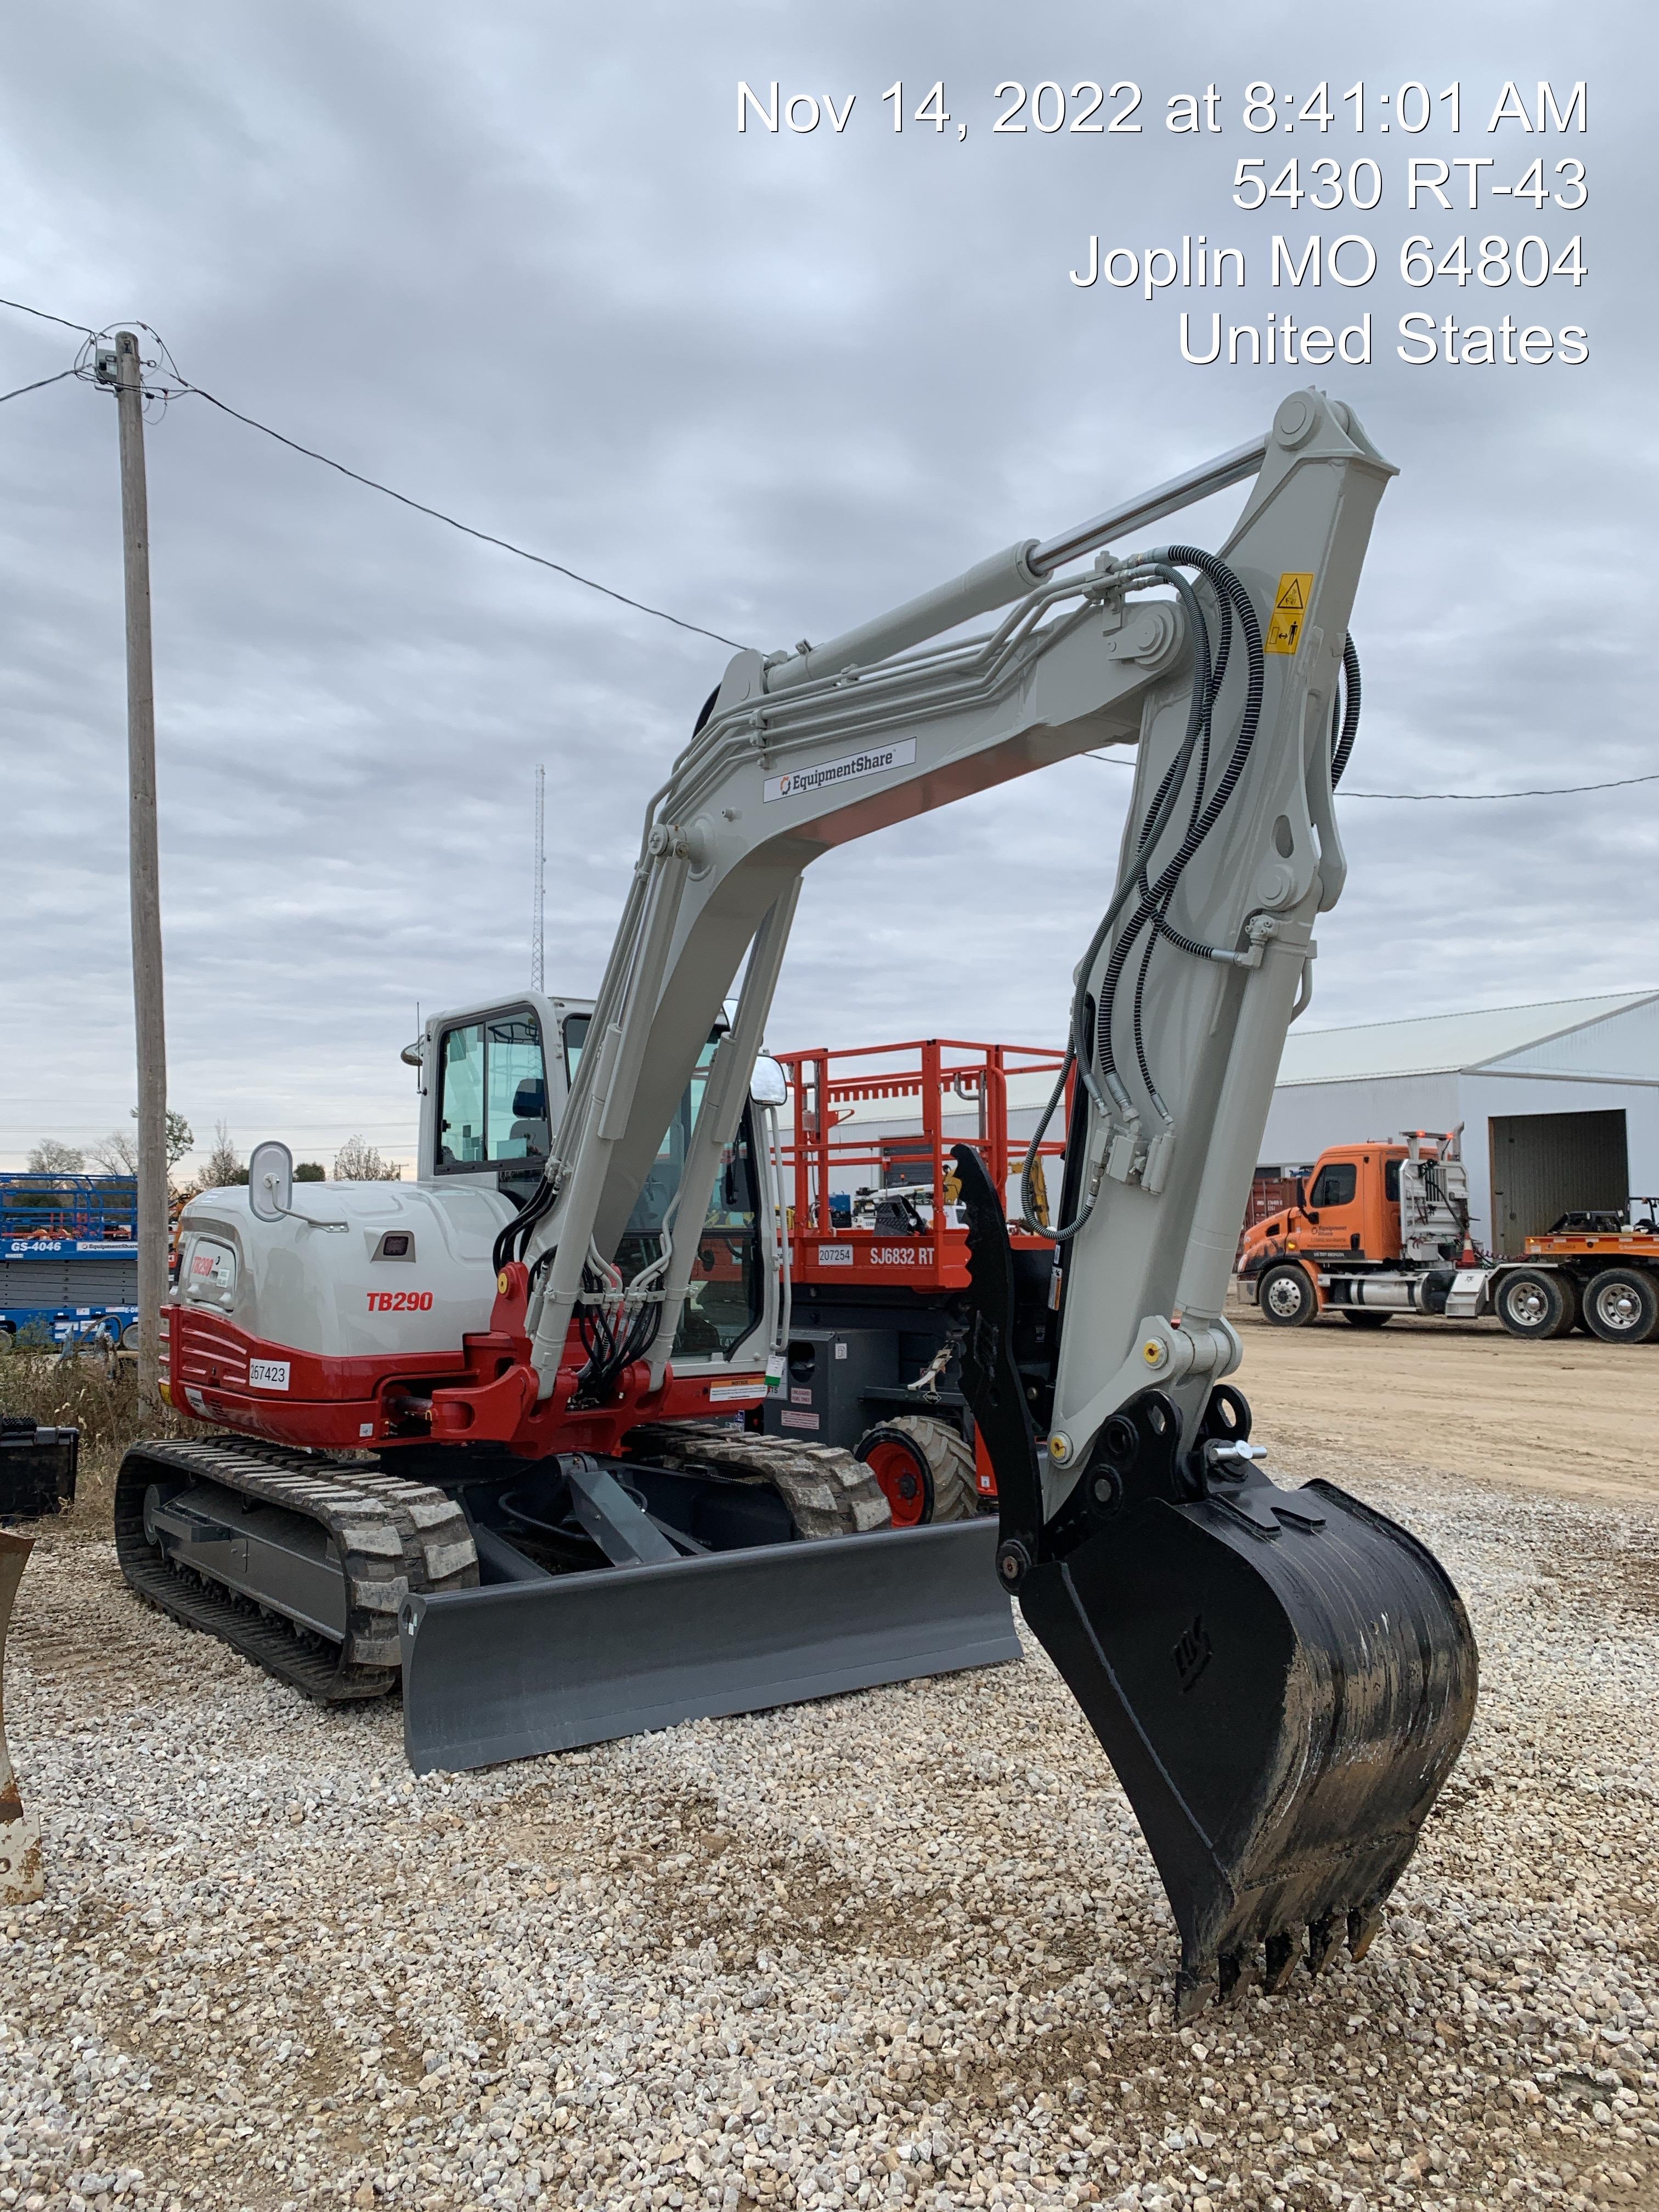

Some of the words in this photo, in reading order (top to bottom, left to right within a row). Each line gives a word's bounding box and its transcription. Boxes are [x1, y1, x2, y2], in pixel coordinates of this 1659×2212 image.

[792, 751, 893, 791] EquipmentShare
[11, 1242, 61, 1251] GS-4046
[820, 1250, 850, 1261] 207254
[870, 1247, 915, 1265] SJ6832
[918, 1248, 935, 1265] RT
[192, 1256, 213, 1277] TB290
[366, 1291, 433, 1311] TB290
[251, 1364, 285, 1382] 267423
